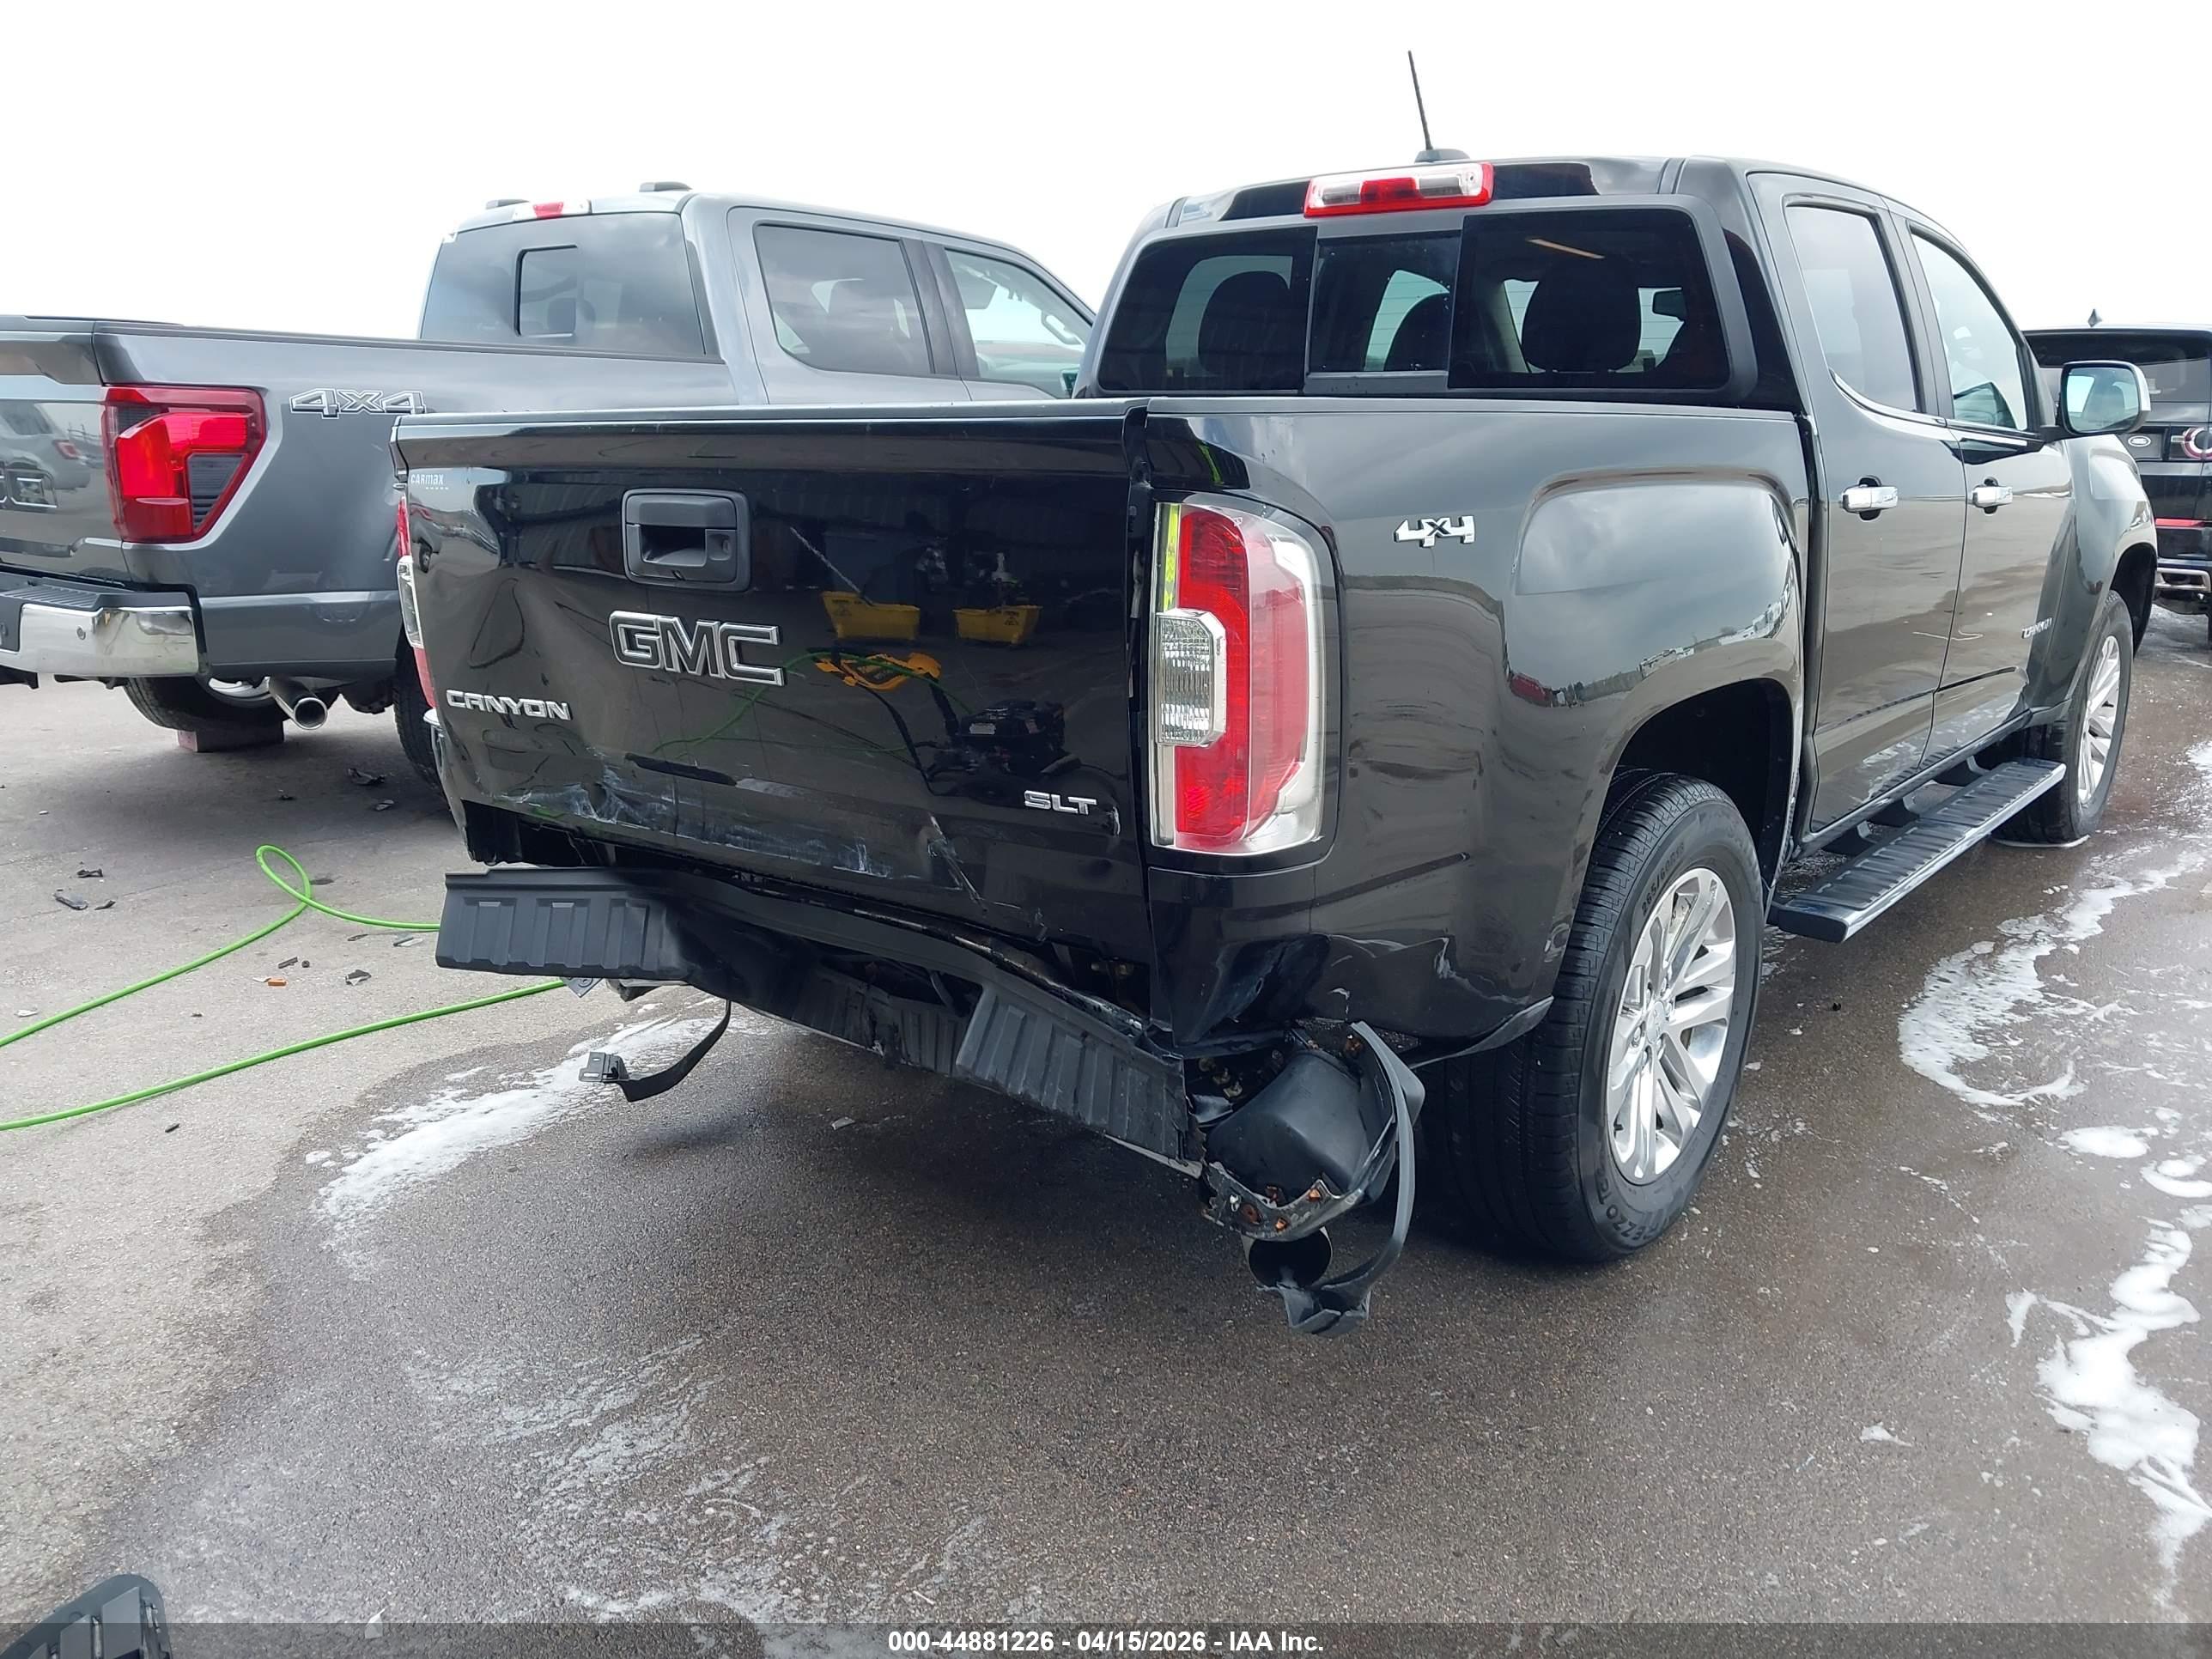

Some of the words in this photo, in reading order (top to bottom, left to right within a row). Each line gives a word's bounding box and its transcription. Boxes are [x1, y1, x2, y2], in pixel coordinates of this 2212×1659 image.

[609, 610, 785, 687] GMC
[446, 690, 573, 721] CANYON
[1024, 790, 1097, 815] SLT
